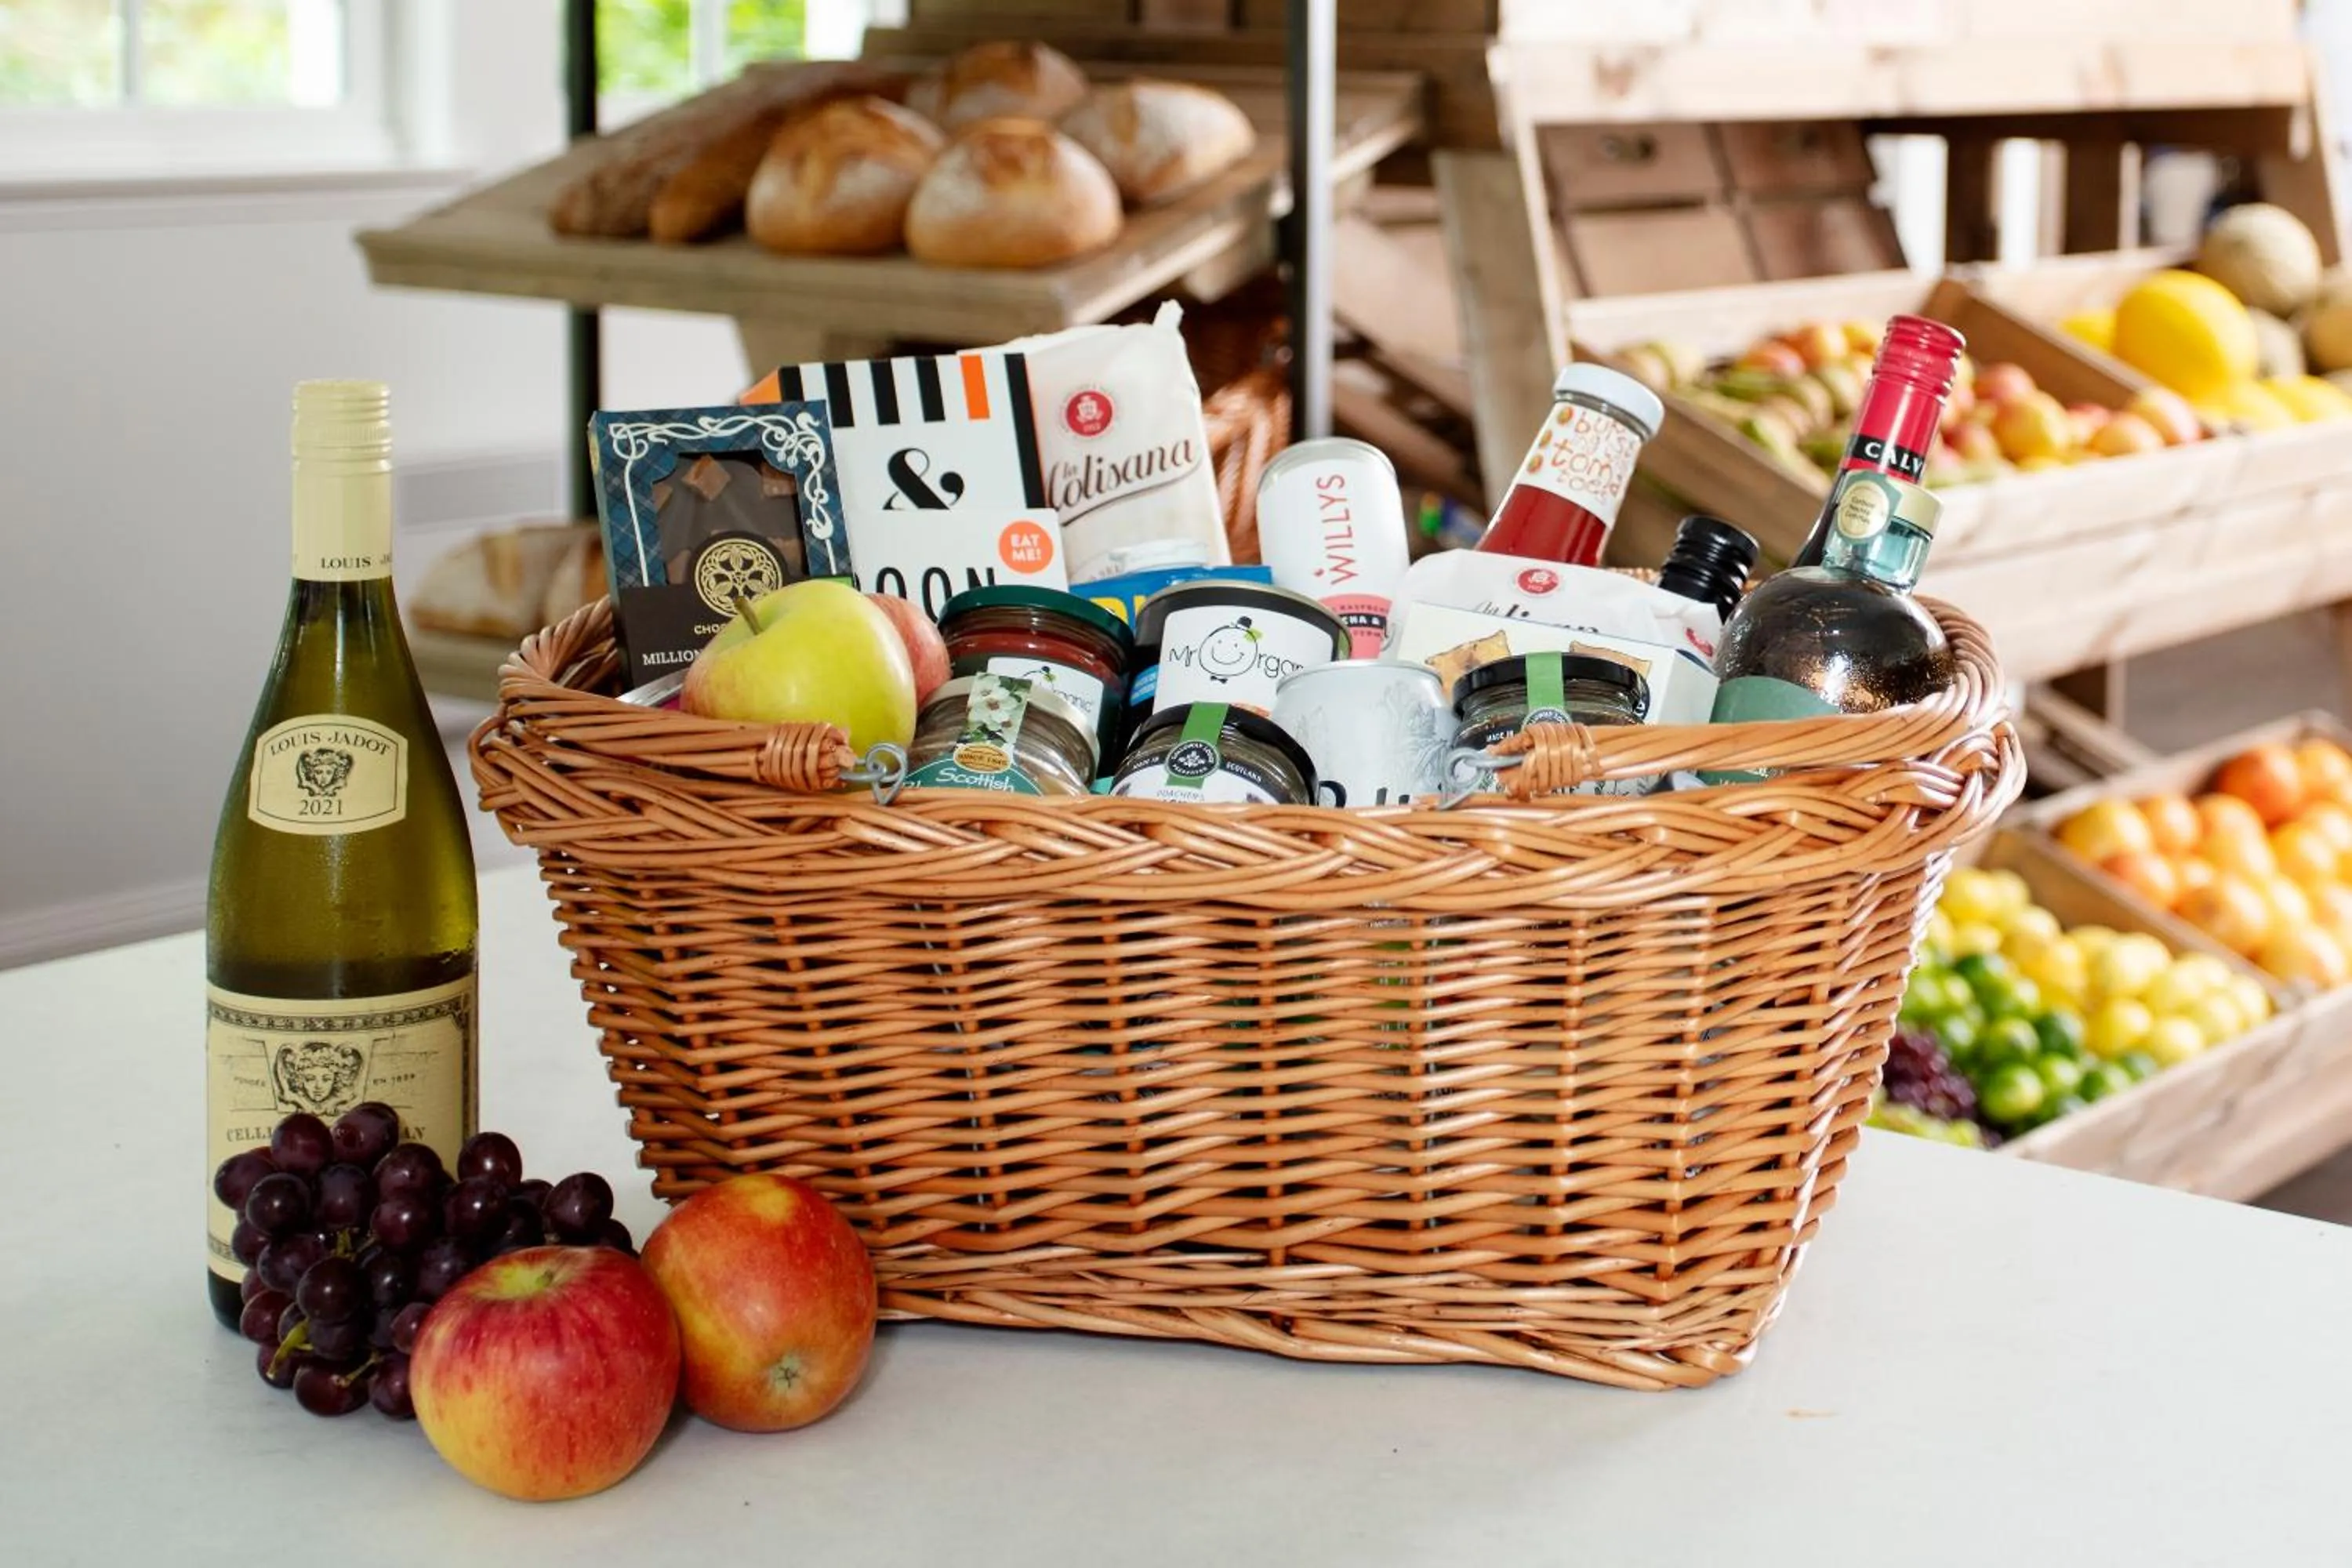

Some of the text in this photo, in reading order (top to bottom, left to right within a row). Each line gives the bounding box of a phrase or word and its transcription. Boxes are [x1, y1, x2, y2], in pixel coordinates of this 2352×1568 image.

[882, 448, 965, 510] &
[1010, 533, 1040, 548] EAT
[1316, 474, 1359, 585] WILLYS
[321, 556, 372, 569] LOUIS
[1011, 548, 1043, 562] ME!
[1169, 645, 1198, 667] Mr
[270, 731, 391, 756] LOUIS JADOT
[935, 767, 1014, 793] Scottish
[298, 798, 343, 816] 2021
